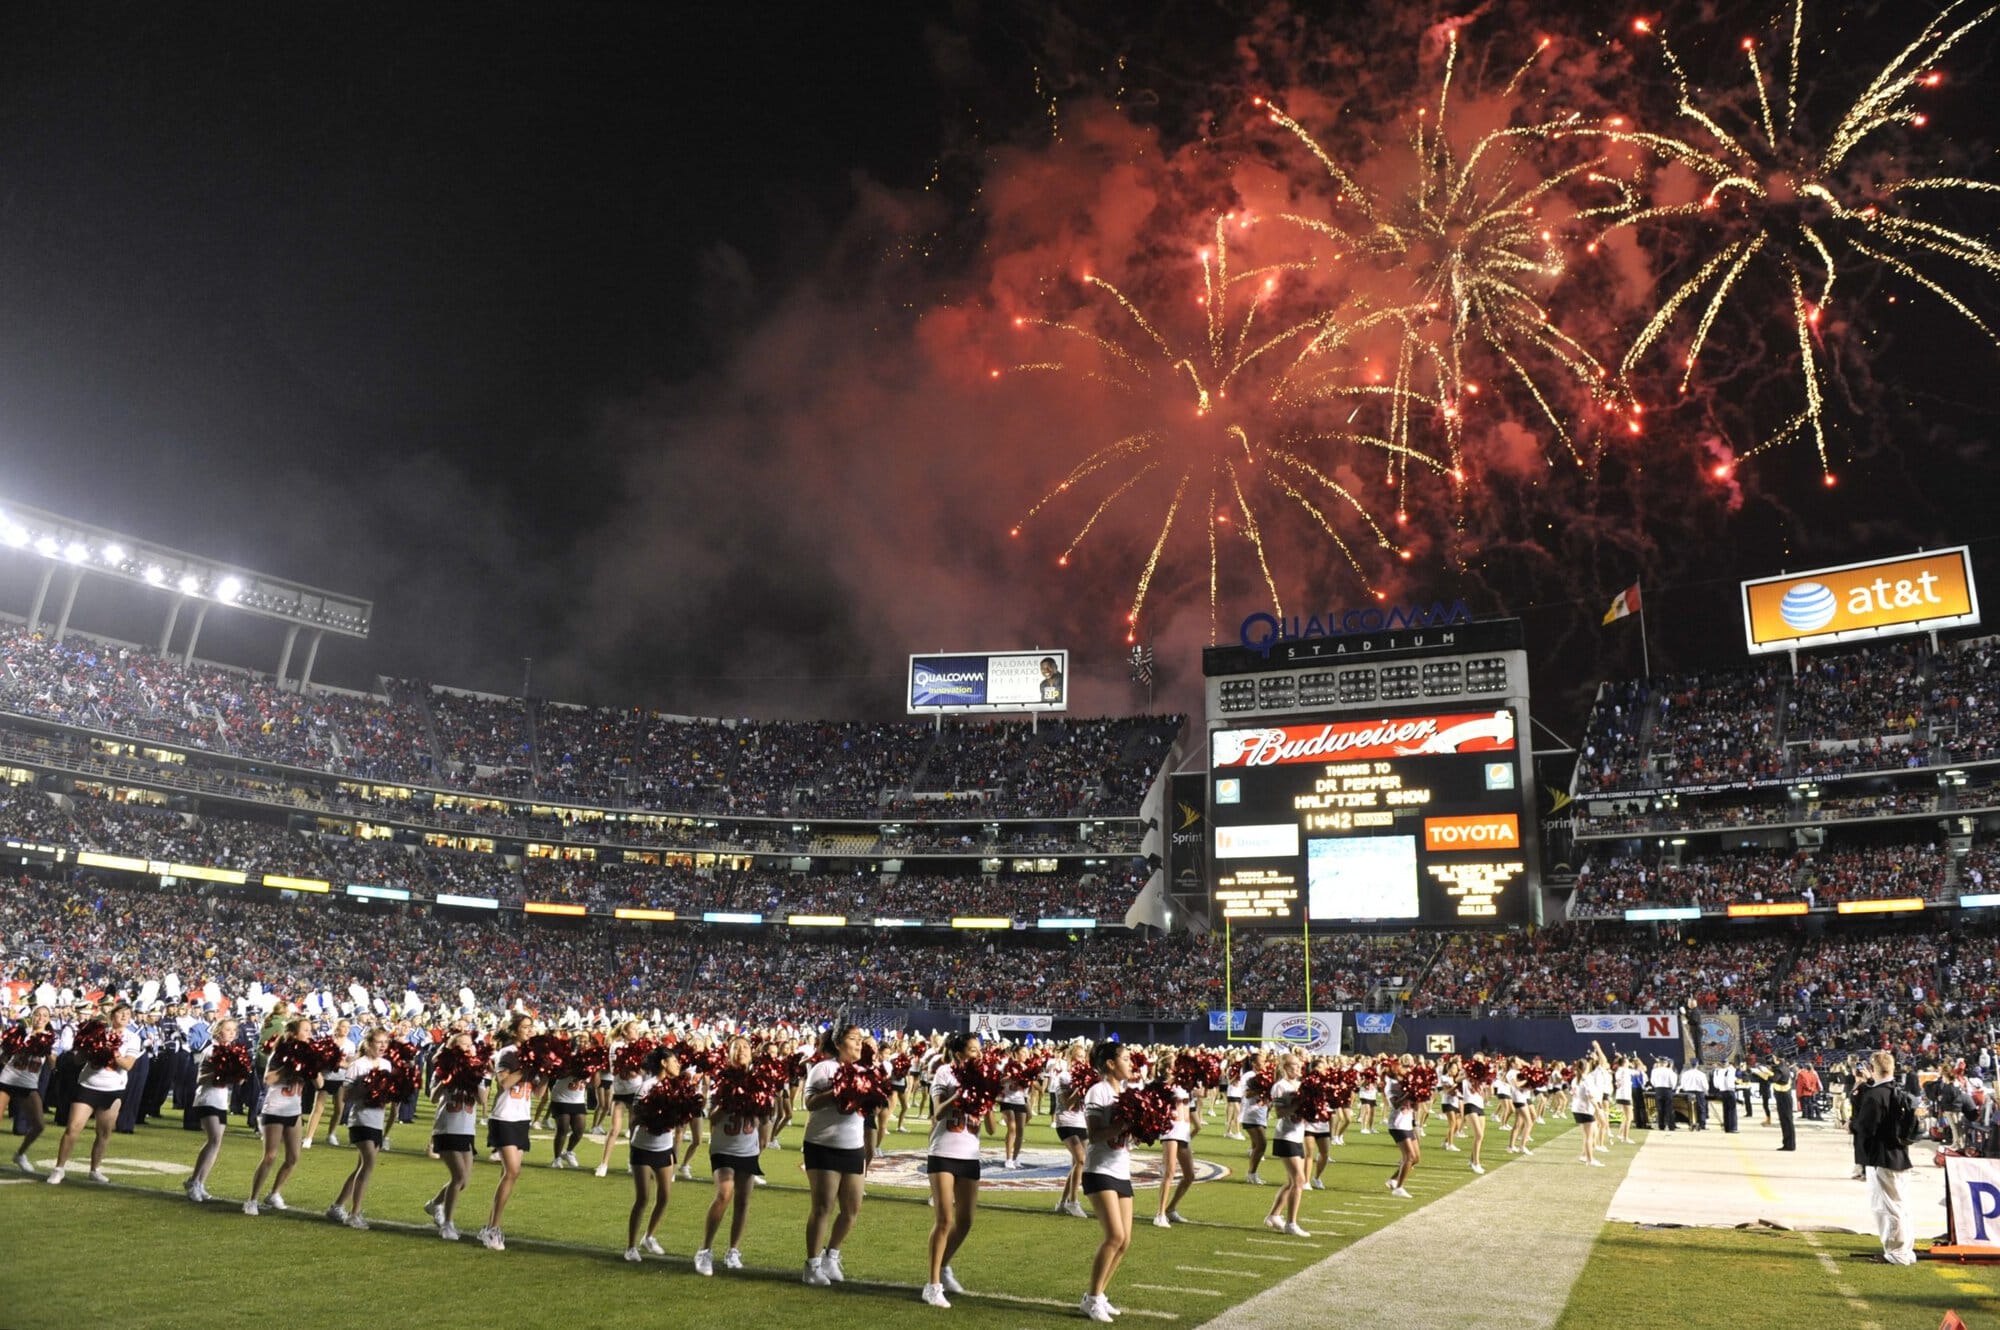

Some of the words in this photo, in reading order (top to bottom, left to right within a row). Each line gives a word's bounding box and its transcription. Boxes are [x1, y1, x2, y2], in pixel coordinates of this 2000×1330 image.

[1847, 571, 1942, 615] at&t
[1240, 599, 1472, 659] QUALCOMM
[1288, 633, 1455, 658] STADIUM
[991, 659, 1039, 668] PALOMAR
[991, 668, 1039, 676] POMERADO
[916, 672, 984, 687] QUALCOMM
[1241, 719, 1437, 767] Budweiser
[1326, 764, 1370, 777] THANKS
[1374, 763, 1391, 774] TO
[1316, 779, 1337, 793] DR
[1343, 776, 1402, 791] PEPPER
[1295, 793, 1377, 809] HALFTIME
[1386, 790, 1430, 804] SHOW
[1540, 817, 1571, 831] Sprin
[1172, 831, 1203, 846] Sprint
[1429, 824, 1515, 843] TOYOTA
[1281, 1018, 1308, 1028] PACIFIC
[1647, 1017, 1670, 1036] N
[1430, 1035, 1451, 1052] 25
